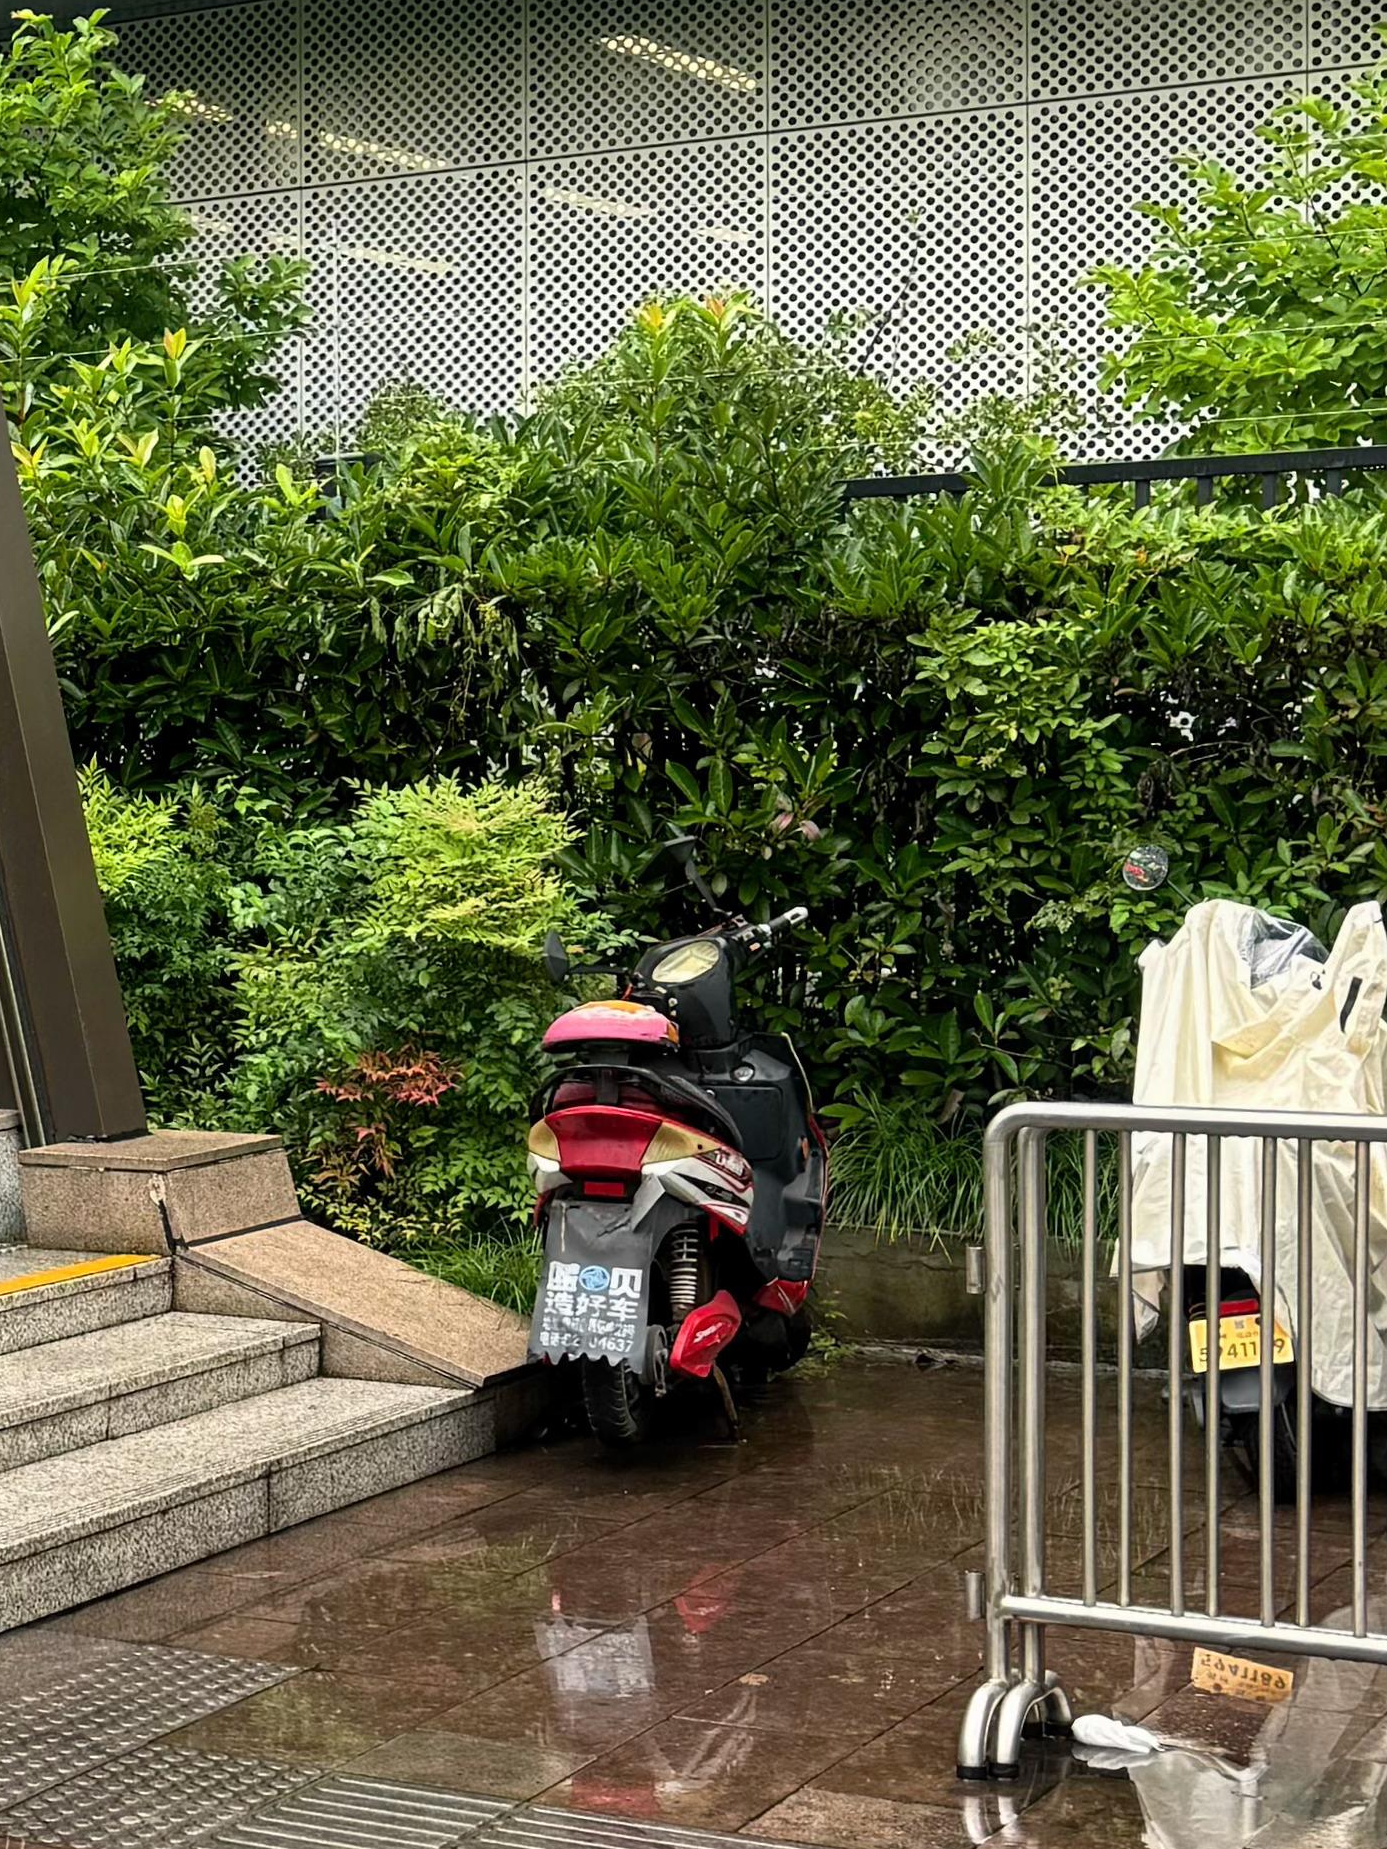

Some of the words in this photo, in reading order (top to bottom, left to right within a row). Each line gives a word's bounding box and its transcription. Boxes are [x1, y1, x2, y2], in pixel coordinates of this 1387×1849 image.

[544, 1291, 639, 1322] 造好车
[1200, 1337, 1286, 1363] 54119
